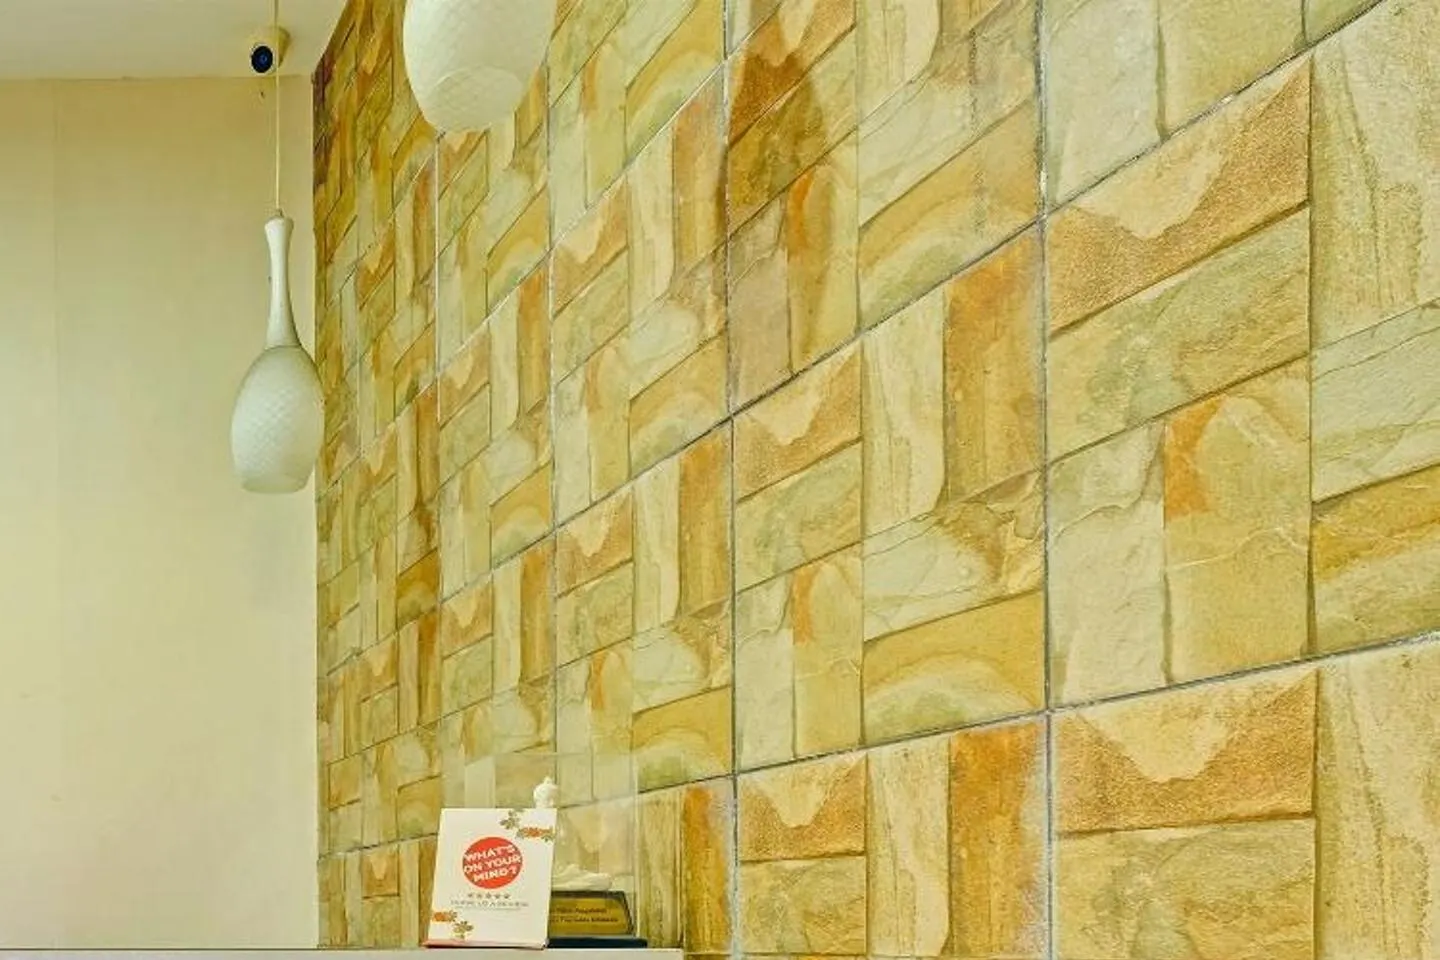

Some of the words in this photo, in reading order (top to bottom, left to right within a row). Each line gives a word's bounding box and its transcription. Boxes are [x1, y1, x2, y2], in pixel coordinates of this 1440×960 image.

[464, 844, 515, 862] WHAT'S
[464, 863, 483, 874] ON
[485, 855, 521, 868] YOUR
[473, 866, 517, 882] MIND?
